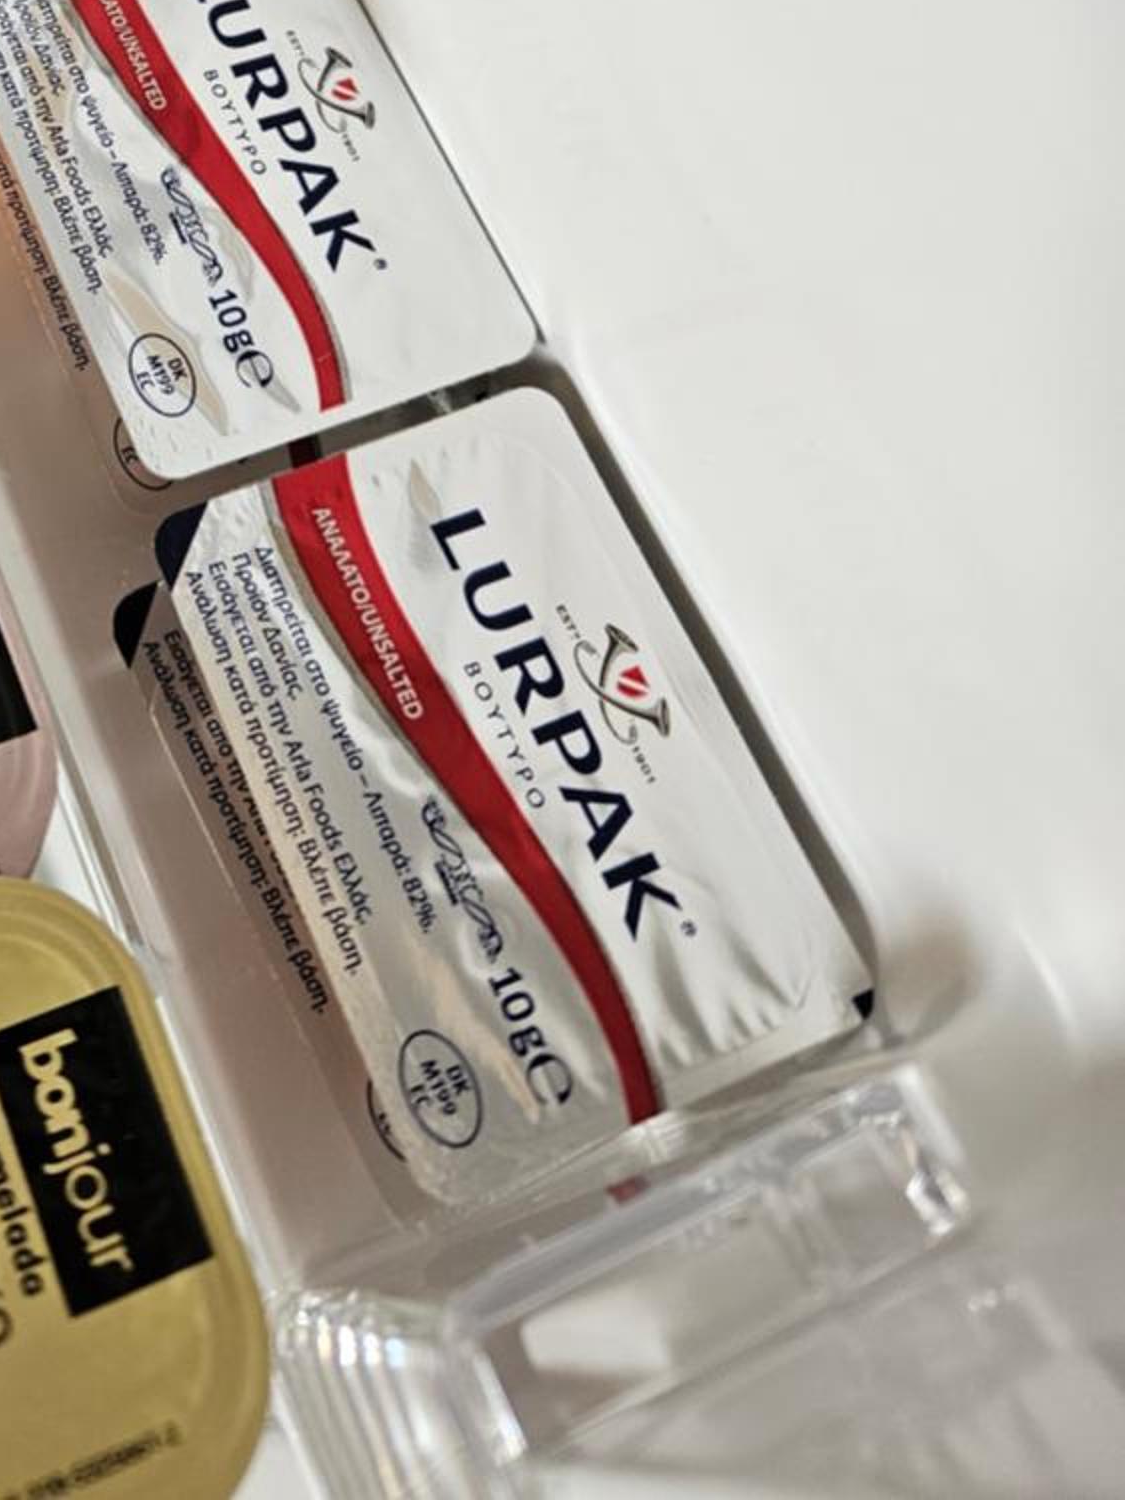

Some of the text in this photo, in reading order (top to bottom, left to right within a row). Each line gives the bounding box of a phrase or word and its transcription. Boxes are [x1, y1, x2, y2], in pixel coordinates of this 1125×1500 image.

[70, 59, 90, 95] στο
[78, 93, 114, 149] ψυγείο
[203, 68, 267, 176] ΒΟΥΤΥΡΟ
[0, 70, 27, 110] κατά
[15, 106, 62, 198] προτίμηση:
[53, 196, 85, 253] Βλέπε
[20, 64, 44, 97] από
[33, 95, 56, 125] την
[46, 123, 70, 160] Arla
[60, 157, 93, 208] Foods
[111, 161, 148, 225] Λιπαρά:
[43, 275, 71, 327] Βλέπε
[136, 371, 156, 392] EC
[148, 354, 176, 396] M199
[168, 357, 187, 383] DK
[231, 551, 271, 625] Προϊόν
[208, 560, 257, 657] Εισάγεται
[247, 654, 277, 699] από
[267, 698, 294, 738] την
[283, 735, 313, 785] Arla
[304, 782, 344, 856] Foods
[255, 546, 438, 934] Διατηρείται στο ψυγείο Λιπαρά: 82%.
[430, 507, 682, 942] LURPAK
[463, 660, 546, 810] ΒΟΥΤΥΡΟ
[184, 569, 233, 665] Ανάλωση
[223, 664, 256, 716] κατά
[246, 716, 307, 838] προτίμηση:
[296, 838, 337, 905] Βλέπε
[323, 906, 364, 977] βάση.
[183, 729, 214, 777] κατά
[205, 775, 268, 889] προτίμηση:
[261, 887, 303, 953] Βλέπε
[446, 1065, 471, 1096] DK
[18, 1027, 135, 1271] bonjour
